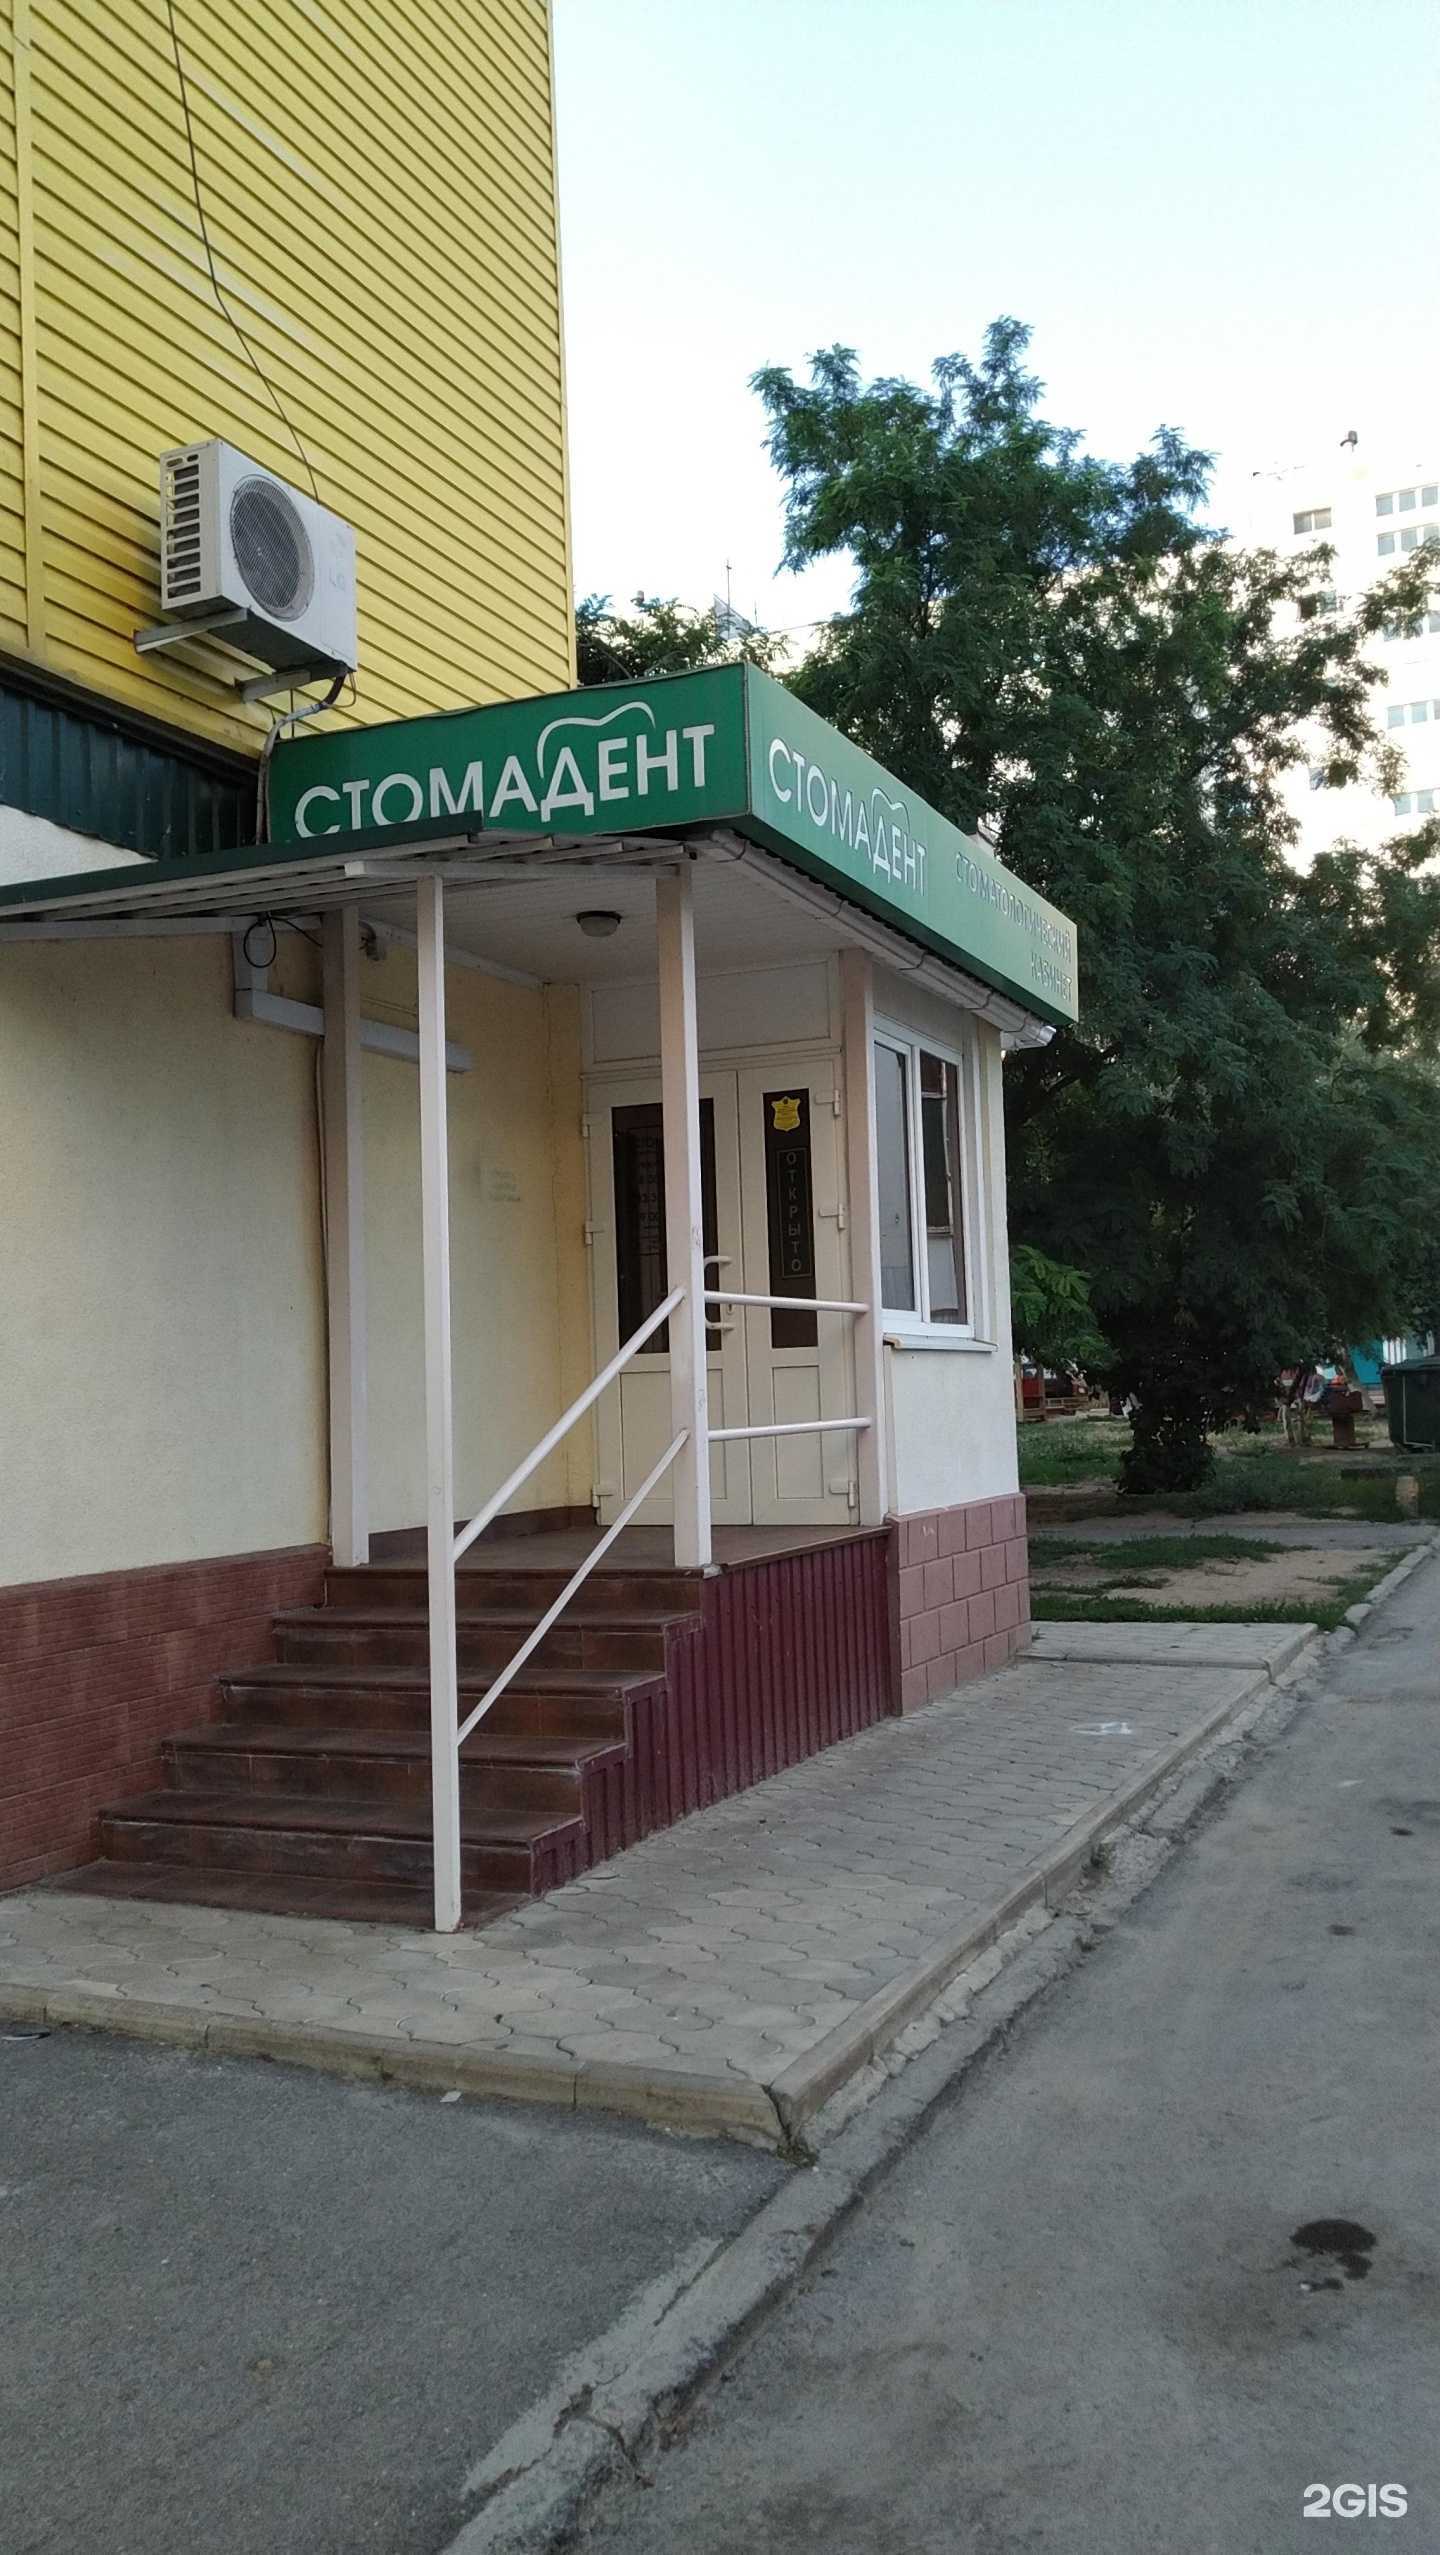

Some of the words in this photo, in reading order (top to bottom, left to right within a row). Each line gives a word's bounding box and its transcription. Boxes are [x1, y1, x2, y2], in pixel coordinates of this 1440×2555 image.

[294, 723, 716, 838] СТОМАДЕНТ
[768, 737, 928, 897] СТОМАДЕНТ
[955, 851, 1072, 964] СТОМАТОЛОГИЧЕСКИЙ
[1031, 951, 1072, 1002] КАБИНЕТ
[785, 1151, 802, 1273] ОТКРЫТО
